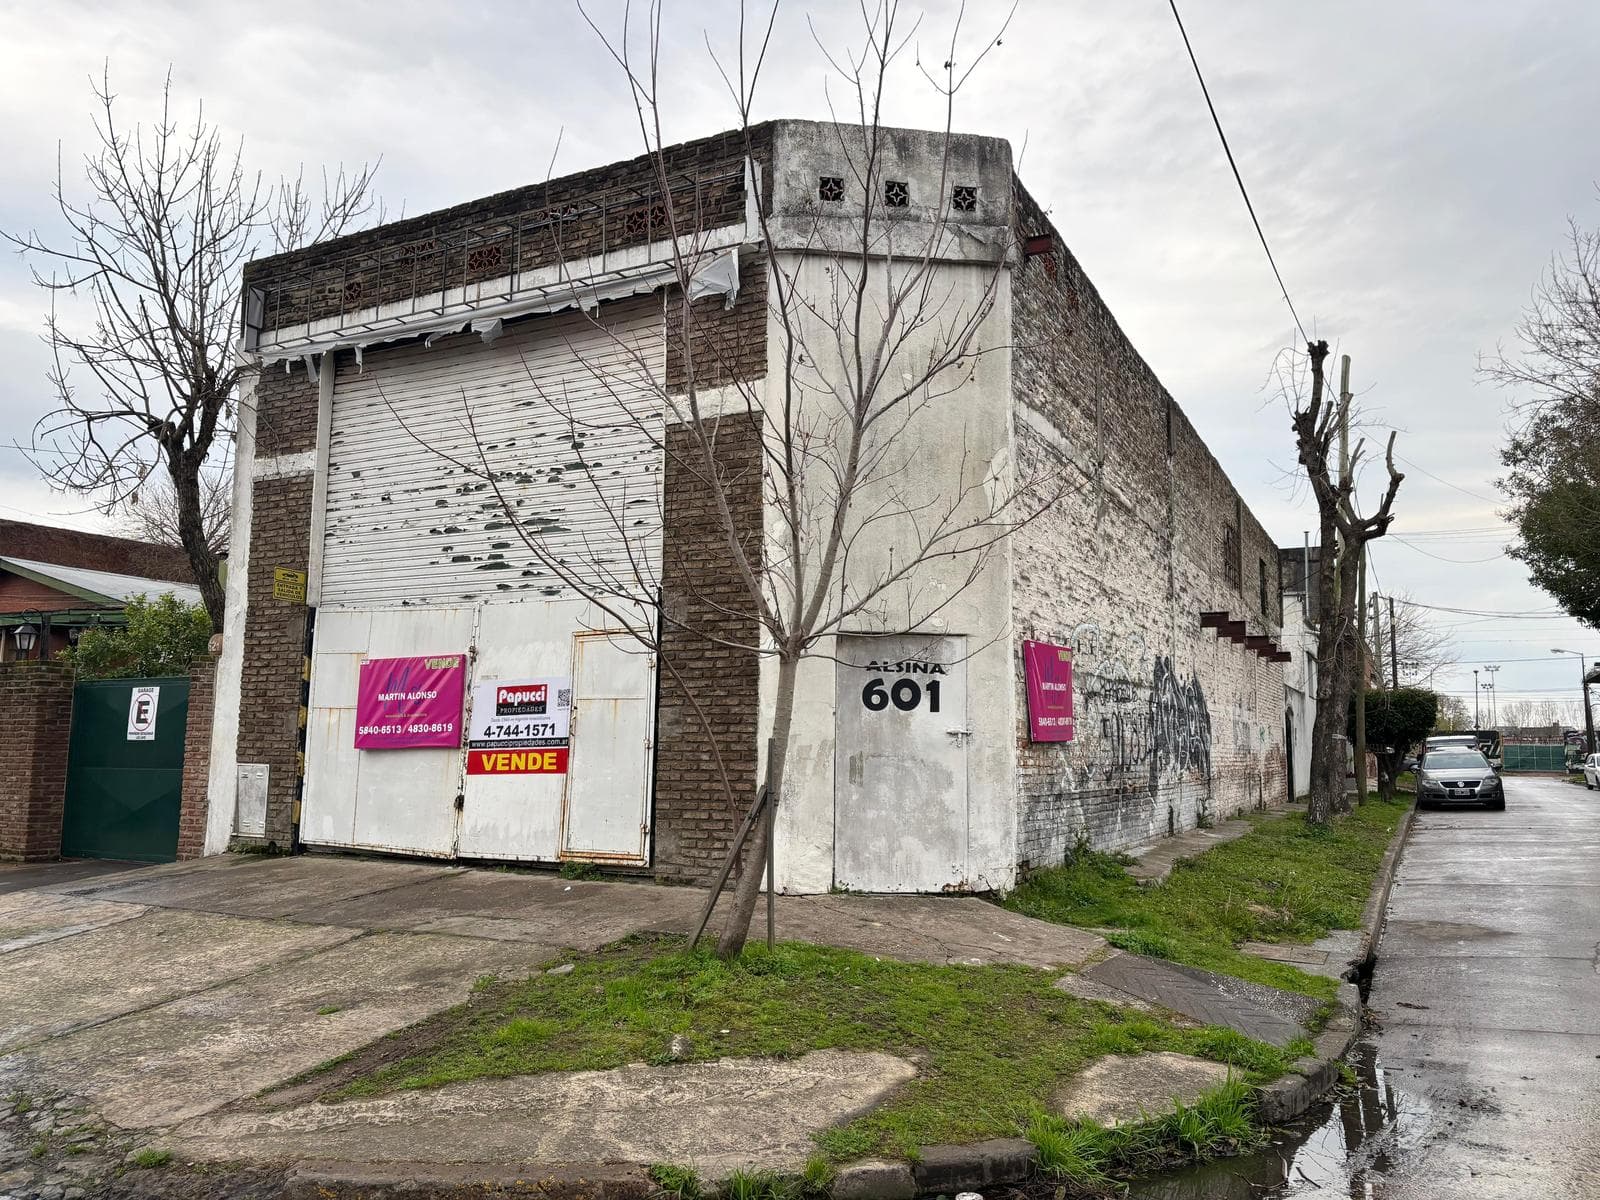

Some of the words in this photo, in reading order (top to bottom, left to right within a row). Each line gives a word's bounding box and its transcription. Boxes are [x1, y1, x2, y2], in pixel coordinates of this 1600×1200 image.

[424, 656, 460, 670] VENDE
[866, 660, 947, 675] ALSINA
[378, 692, 405, 702] MARTIN
[407, 690, 437, 700] ALONSO
[498, 685, 546, 706] Papucci
[862, 678, 941, 712] 601
[135, 700, 150, 724] E
[499, 705, 544, 714] PROPIEDADES
[358, 725, 402, 735] 5840-6513
[407, 723, 453, 734] 4830-8619
[483, 723, 556, 738] 4-744-1571
[481, 752, 557, 771] VENDE
